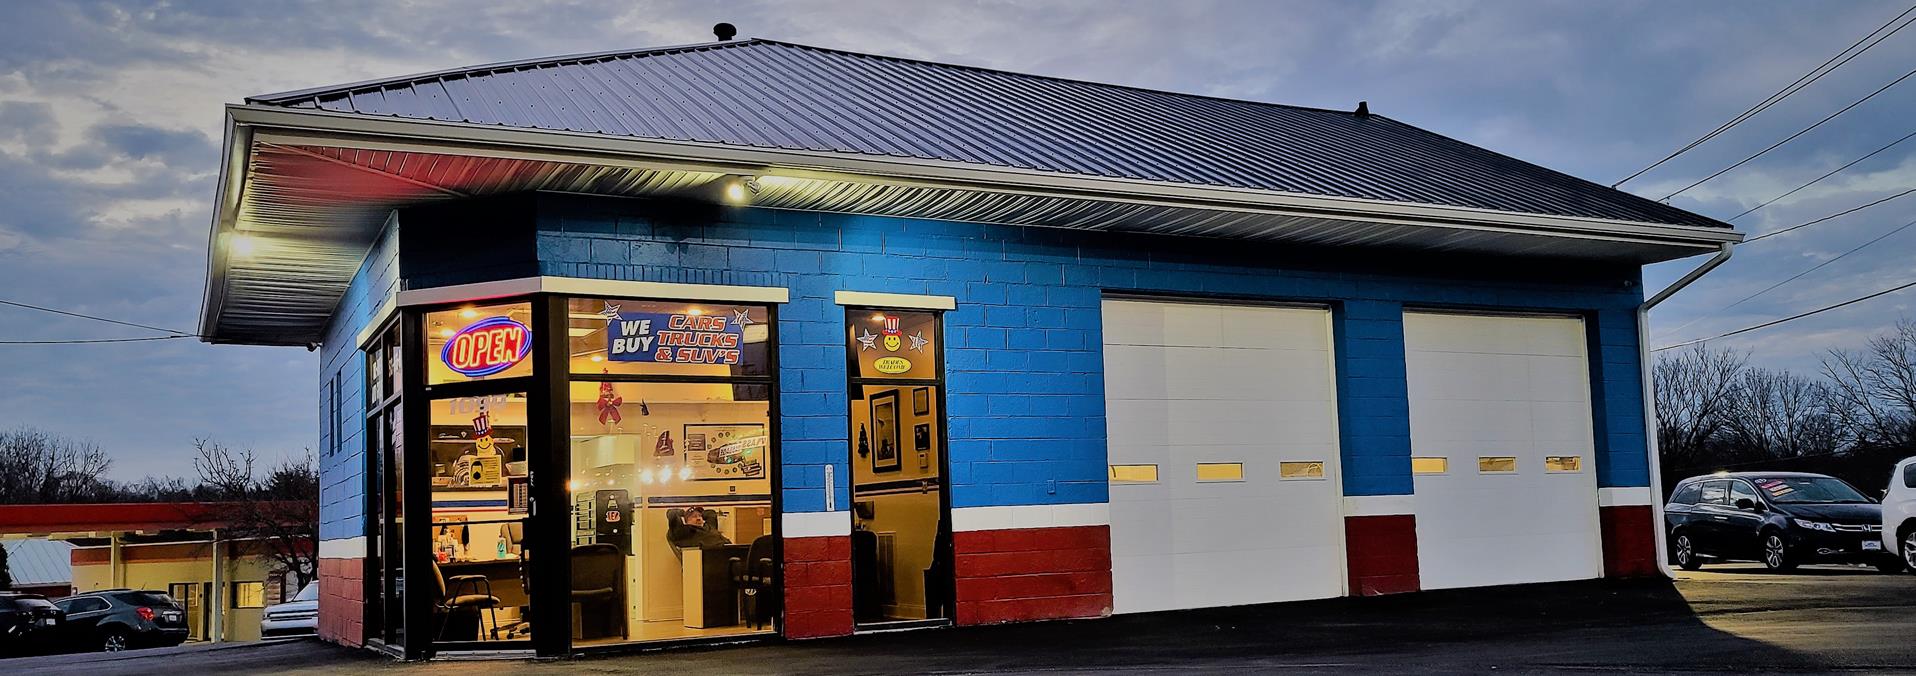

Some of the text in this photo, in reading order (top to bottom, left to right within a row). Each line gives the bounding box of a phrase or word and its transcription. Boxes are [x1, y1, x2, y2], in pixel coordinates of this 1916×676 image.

[620, 319, 651, 337] WE
[668, 314, 727, 331] CARS
[453, 326, 522, 368] OPEN
[611, 336, 655, 354] BUY
[656, 331, 740, 348] TRUCKS
[655, 346, 740, 364] & SUV'S
